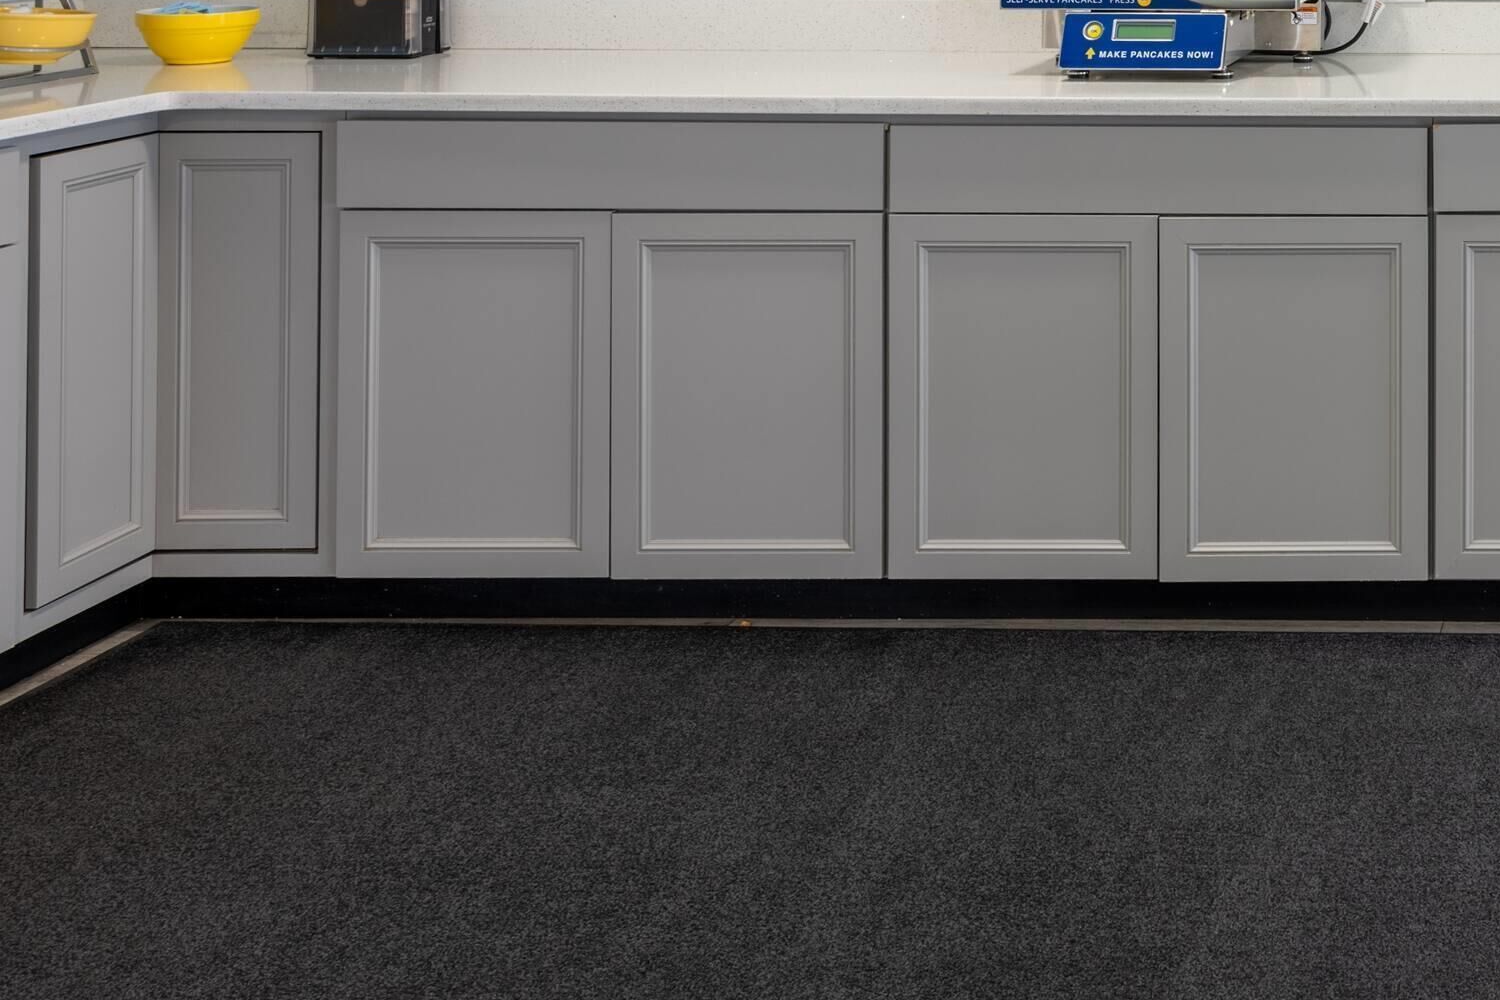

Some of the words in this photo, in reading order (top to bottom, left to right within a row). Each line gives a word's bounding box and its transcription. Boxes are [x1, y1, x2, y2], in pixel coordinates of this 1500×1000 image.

[1099, 50, 1127, 58] MAKE
[1130, 50, 1184, 58] PANCAKES
[1186, 50, 1214, 59] NOW!
